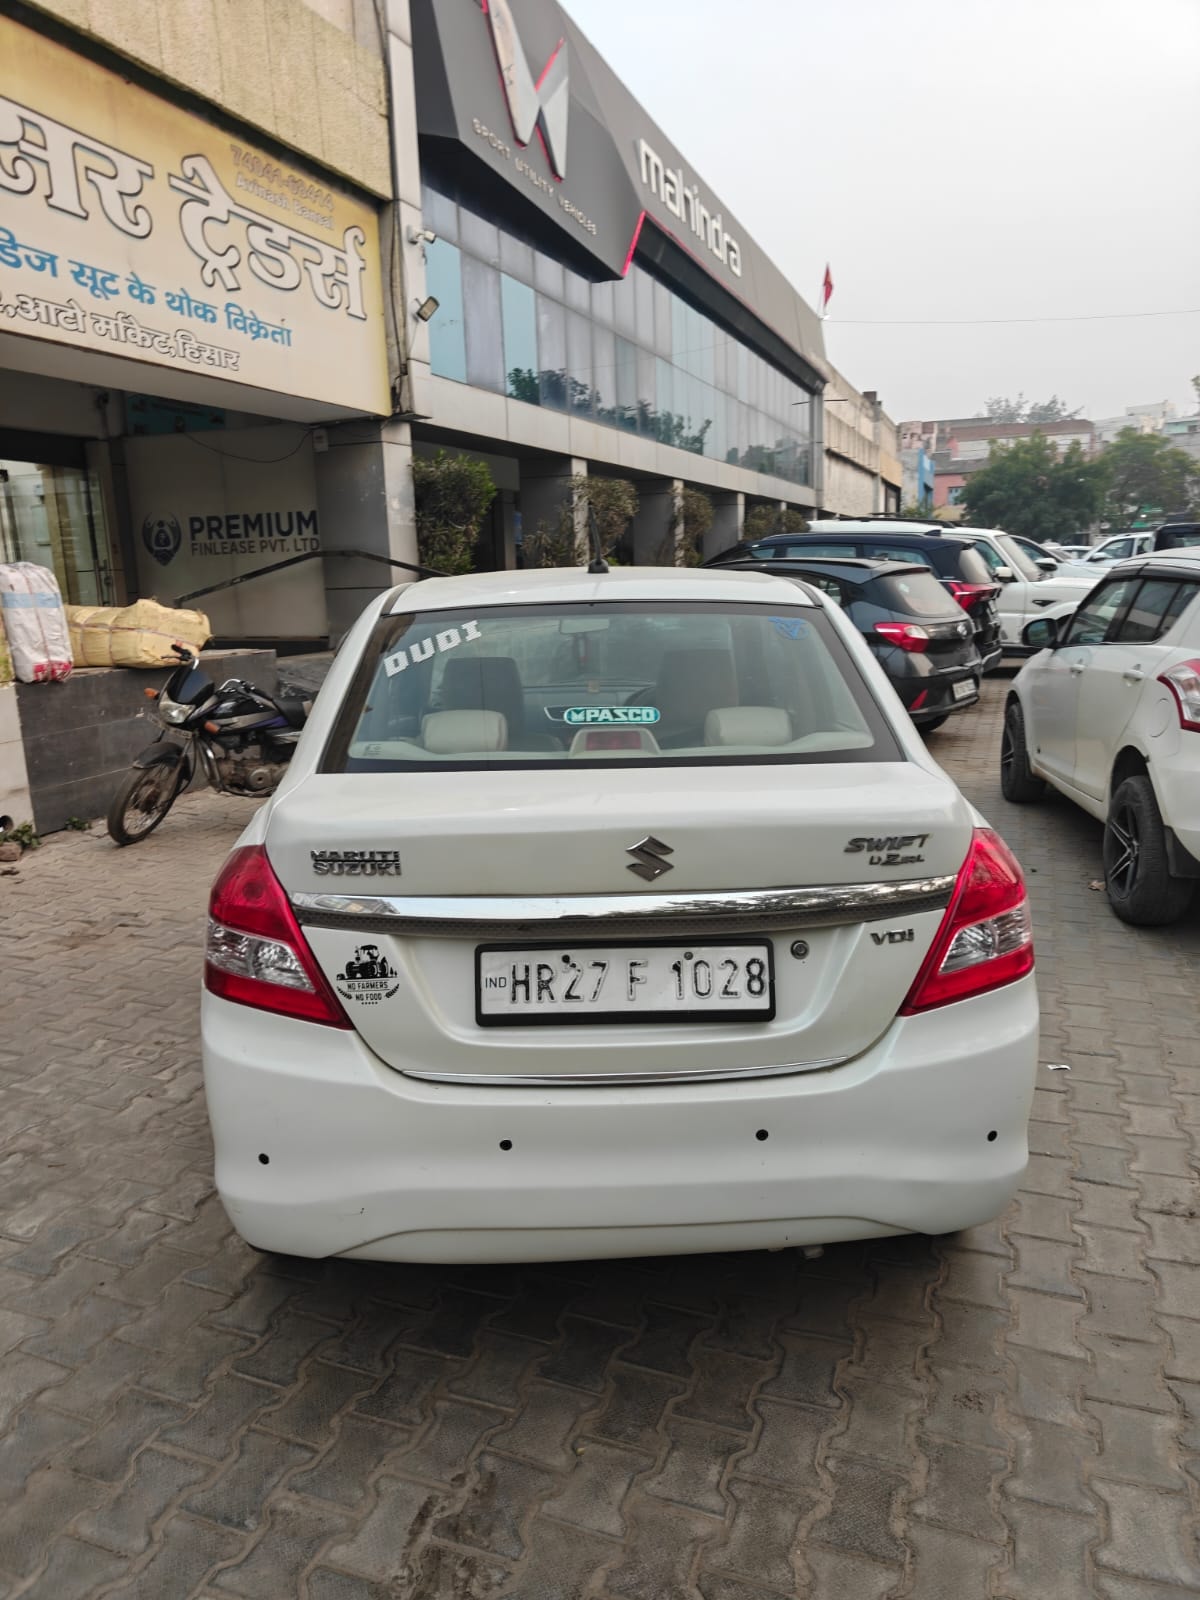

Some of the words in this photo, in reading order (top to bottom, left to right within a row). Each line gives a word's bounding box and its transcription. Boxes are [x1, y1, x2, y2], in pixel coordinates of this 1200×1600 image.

[472, 118, 510, 160] SPORT
[638, 138, 742, 277] mahindra
[168, 153, 367, 321] ट्रेडर्स
[68, 259, 120, 300] सूट
[125, 271, 157, 305] के
[164, 287, 219, 324] थोक
[224, 302, 293, 347] विक्रेता
[189, 510, 319, 540] PREMIUM
[191, 540, 257, 557] FINLEASE
[260, 538, 290, 553] PVT.
[293, 537, 320, 552] LTD
[383, 619, 482, 678] DUDI
[585, 708, 656, 722] PASCO
[310, 849, 400, 862] MARUTI
[844, 834, 931, 854] SWIFT
[312, 861, 402, 876] SUZUKI
[347, 982, 356, 990] NO
[357, 981, 389, 990] FARMERS
[485, 975, 507, 989] IND
[510, 959, 610, 1003] HR27
[627, 959, 649, 1001] F
[671, 957, 767, 1000] 1028
[355, 993, 364, 1001] NO
[365, 992, 383, 1001] FOOD
